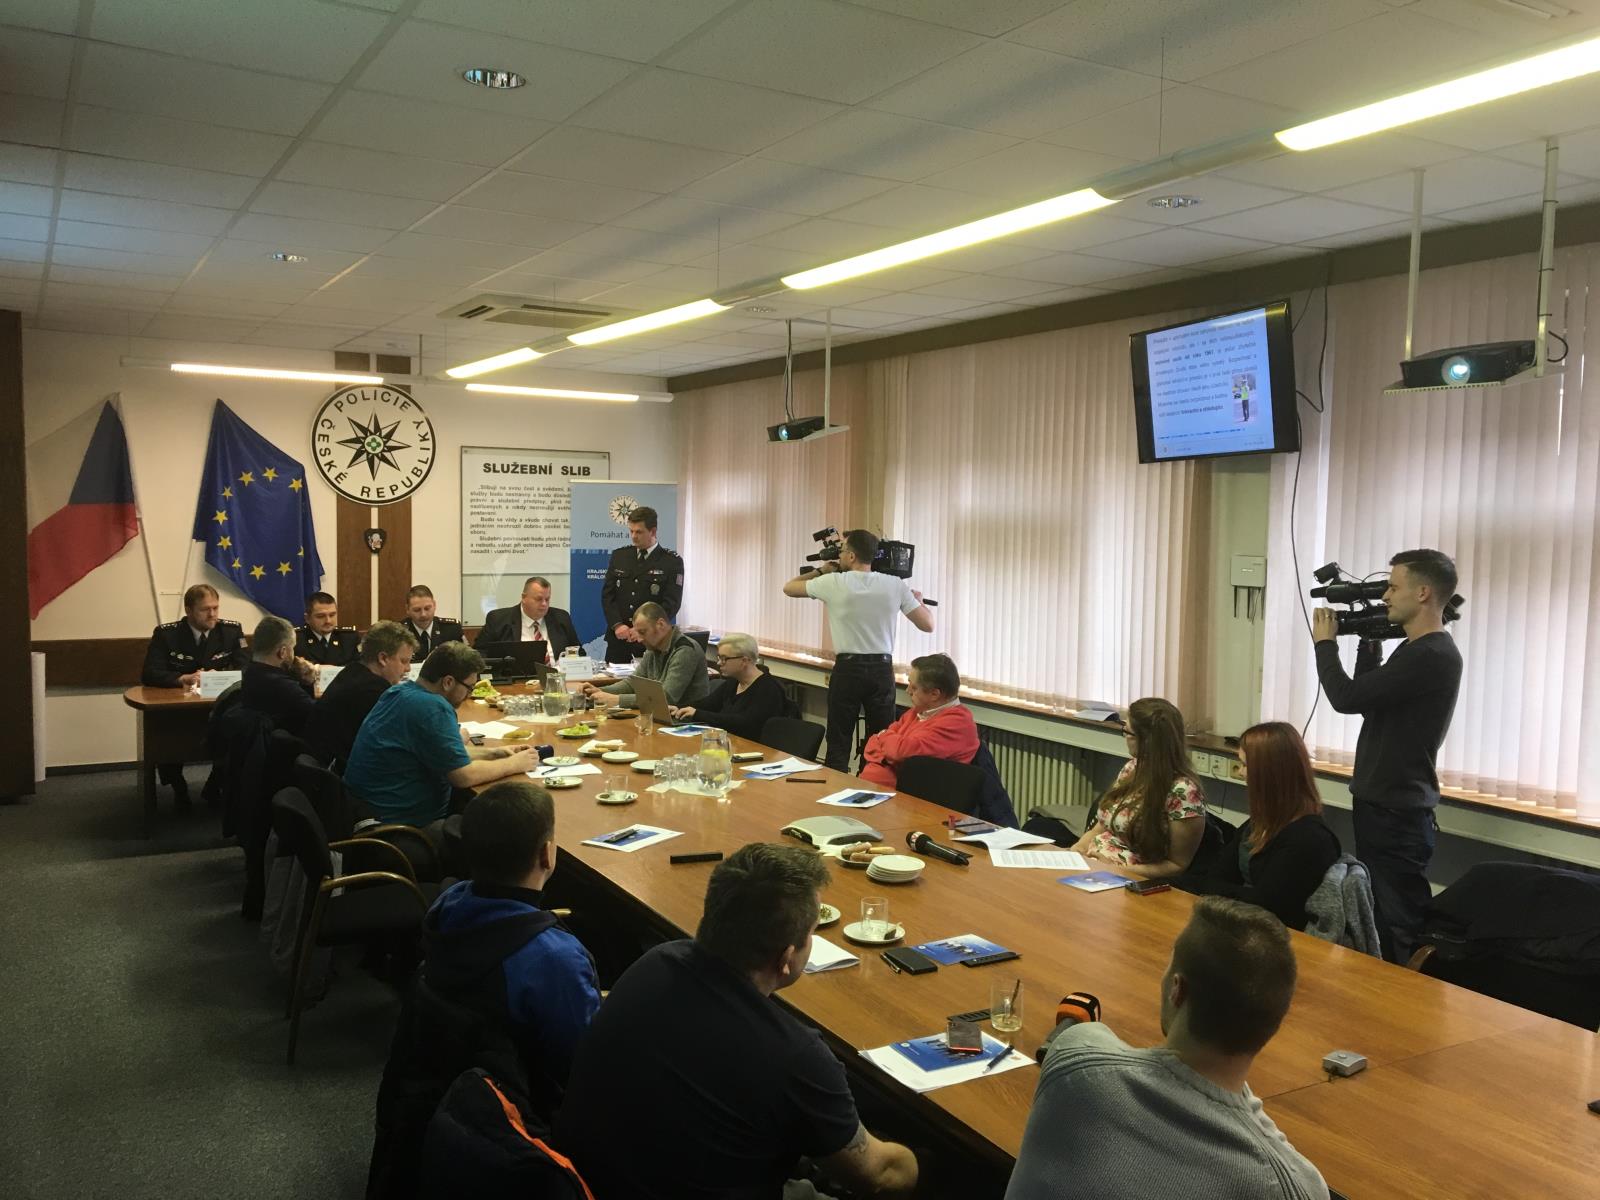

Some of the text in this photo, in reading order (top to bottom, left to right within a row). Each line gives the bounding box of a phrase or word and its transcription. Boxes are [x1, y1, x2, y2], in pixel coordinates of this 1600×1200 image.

[318, 390, 430, 498] POLICIE ČESKÉ REPUBLIKY
[483, 462, 591, 476] SLUŽEBNÍ SLIB
[591, 531, 623, 539] Pomáhat
